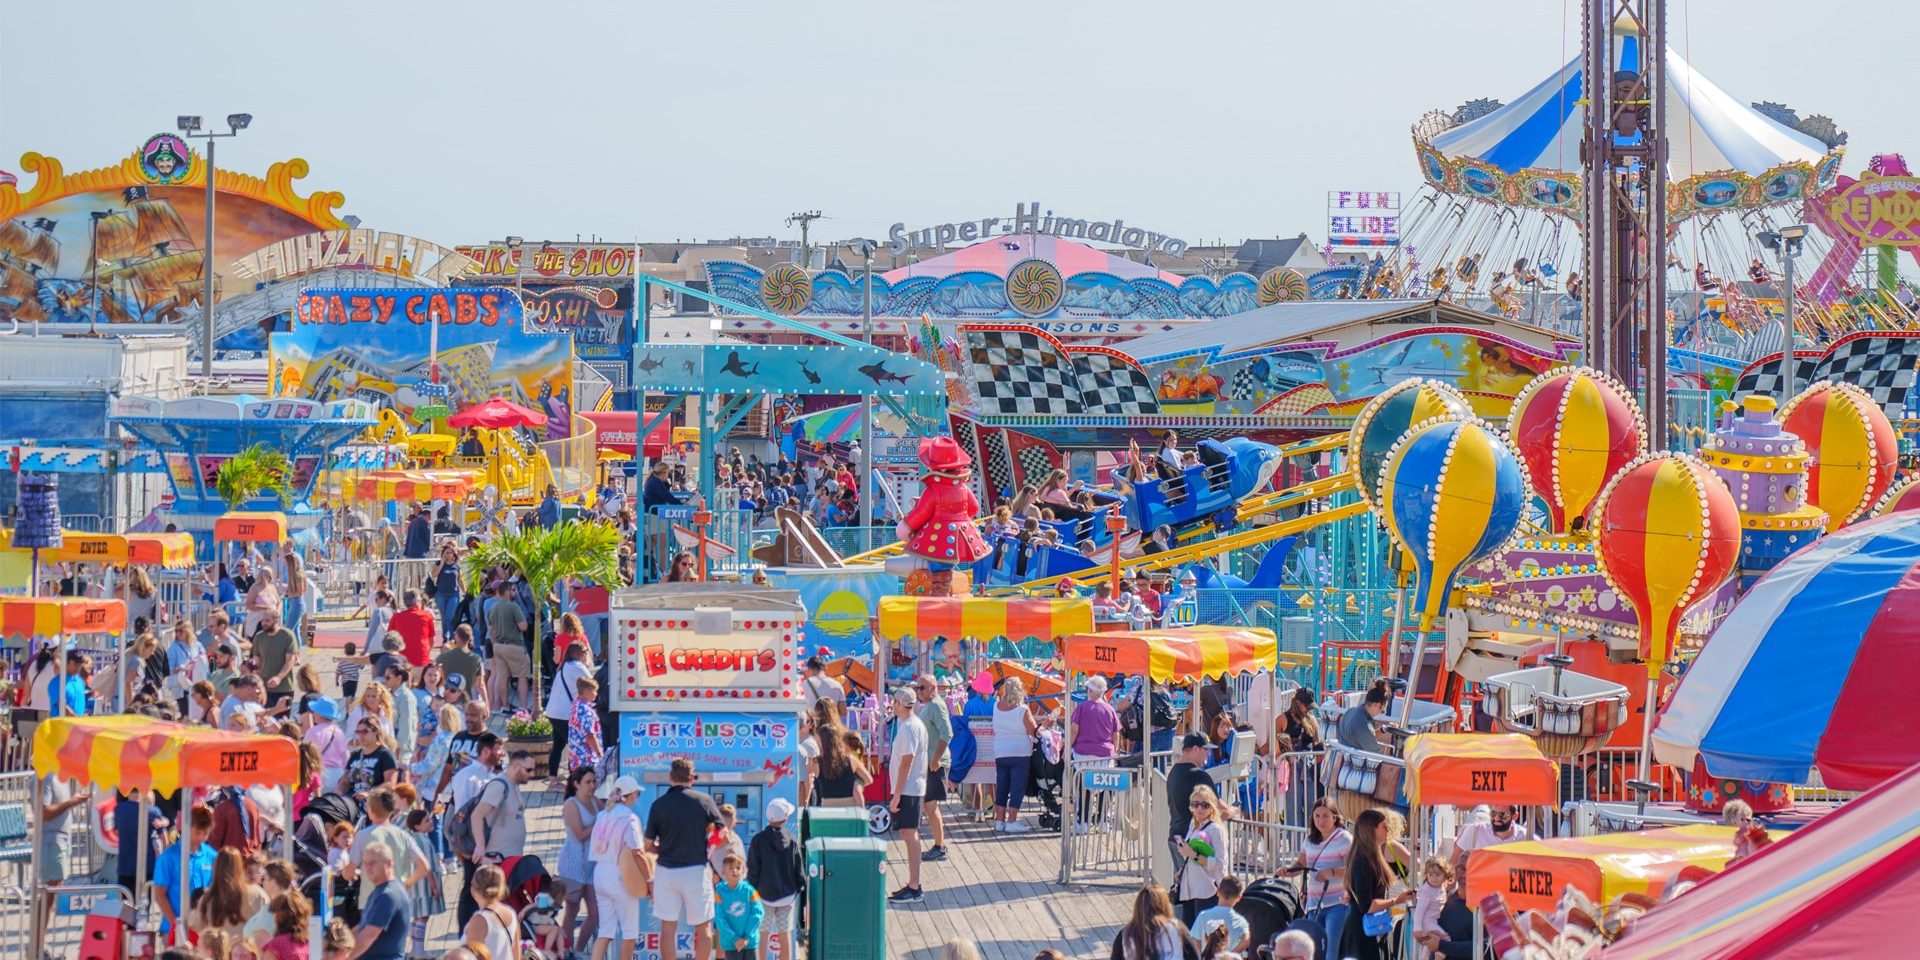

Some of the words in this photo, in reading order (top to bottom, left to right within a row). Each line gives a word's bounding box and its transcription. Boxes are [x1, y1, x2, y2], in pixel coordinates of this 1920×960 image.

[1339, 191, 1388, 208] FUN
[1332, 216, 1396, 233] SLIDE
[534, 252, 565, 271] THE
[569, 248, 643, 276] SHOT
[297, 294, 396, 325] CRAZY
[405, 294, 499, 326] CABS
[664, 509, 688, 518] EXIT
[237, 524, 255, 535] EXIT
[80, 542, 108, 555] ENTER
[84, 609, 106, 625] ENTER
[643, 644, 667, 677] E
[669, 648, 777, 672] CREDITS
[1094, 646, 1118, 662] EXIT
[631, 716, 788, 739] JENKINSON'S
[633, 739, 786, 747] BOARDWALK
[219, 749, 260, 773] ENTER
[624, 755, 655, 766] MAKING
[659, 752, 701, 761] MEMORIES
[704, 754, 728, 766] SINCE
[1093, 772, 1121, 787] EXIT
[1471, 771, 1507, 792] EXIT
[1509, 867, 1553, 897] ENTER
